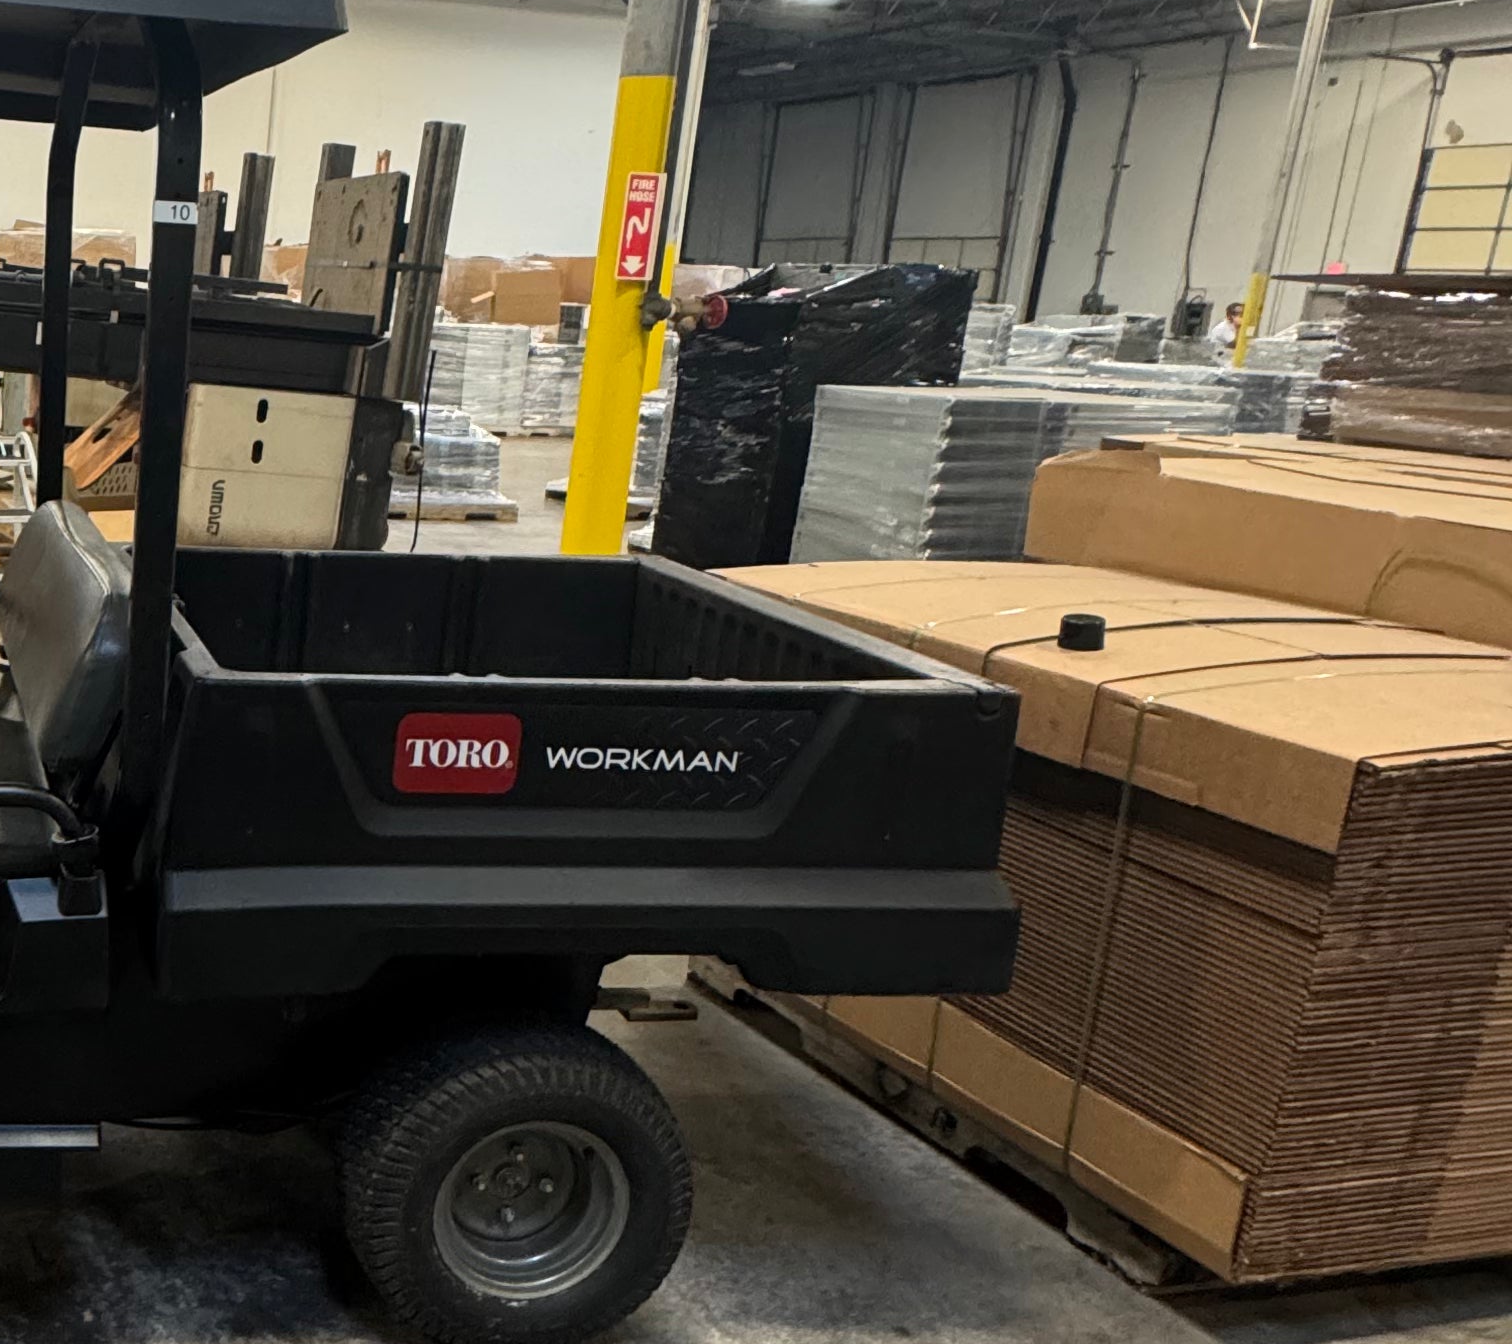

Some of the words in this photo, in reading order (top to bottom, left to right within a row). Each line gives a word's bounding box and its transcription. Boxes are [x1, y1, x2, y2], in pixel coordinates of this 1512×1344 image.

[632, 179, 656, 190] FIRE
[629, 190, 656, 202] HOSE
[171, 204, 190, 220] 10
[206, 479, 226, 536] CROWN
[405, 738, 509, 768] TORO
[546, 747, 738, 772] WORKMAN
